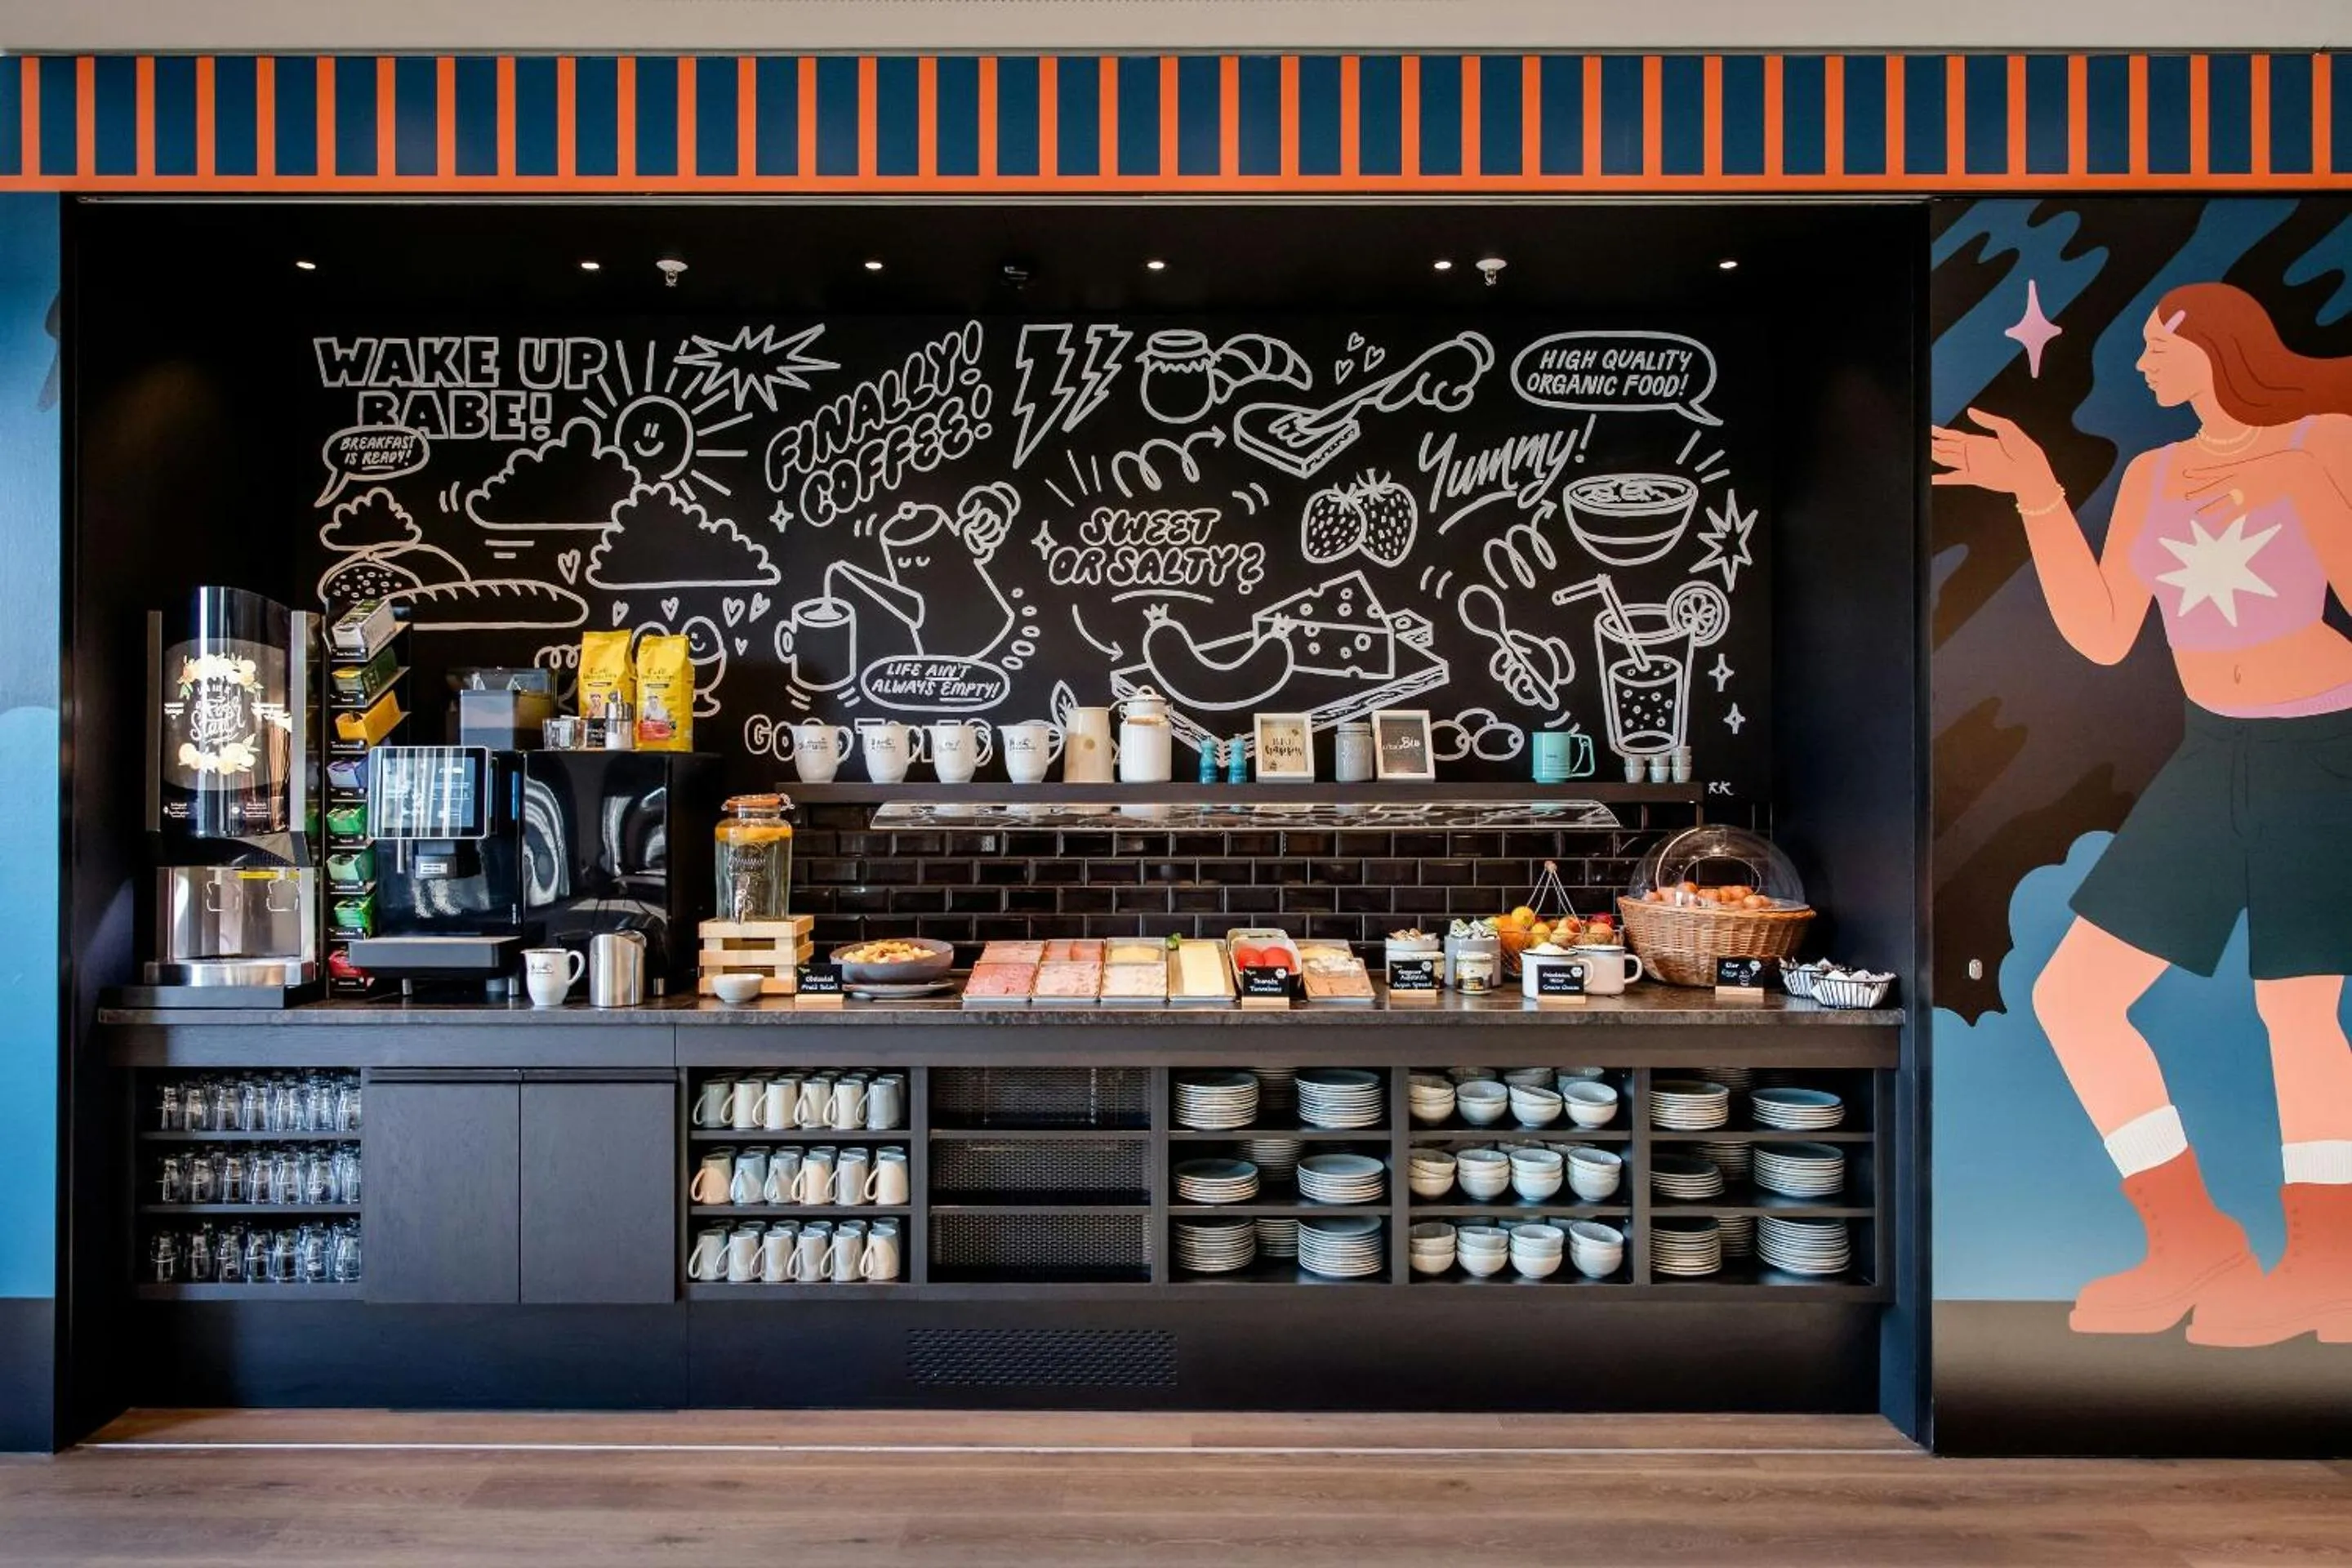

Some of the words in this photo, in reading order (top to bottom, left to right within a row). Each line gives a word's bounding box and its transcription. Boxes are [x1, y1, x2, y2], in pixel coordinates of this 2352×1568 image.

[314, 337, 500, 387] WAKE
[519, 337, 608, 390] UP
[1539, 350, 1598, 369] HIGH
[1601, 349, 1693, 372] QUALITY
[1526, 372, 1618, 396] ORGANIC
[1622, 373, 1690, 397] FOOD!
[358, 390, 553, 442] BABE!
[765, 320, 983, 492] FINALLY!
[340, 435, 416, 450] BREAKFAST
[344, 452, 358, 466] IS
[362, 449, 412, 466] READY!
[800, 385, 992, 527] COFFEE!
[1419, 413, 1597, 513] Yummy!
[1080, 506, 1222, 546] SWEET
[1049, 546, 1106, 585] OR
[1107, 542, 1266, 595] SALTY?
[871, 679, 936, 696] ALWAYS
[940, 681, 1000, 699] EMPTY!
[887, 663, 923, 676] LIFE
[924, 662, 972, 678] AIN'T
